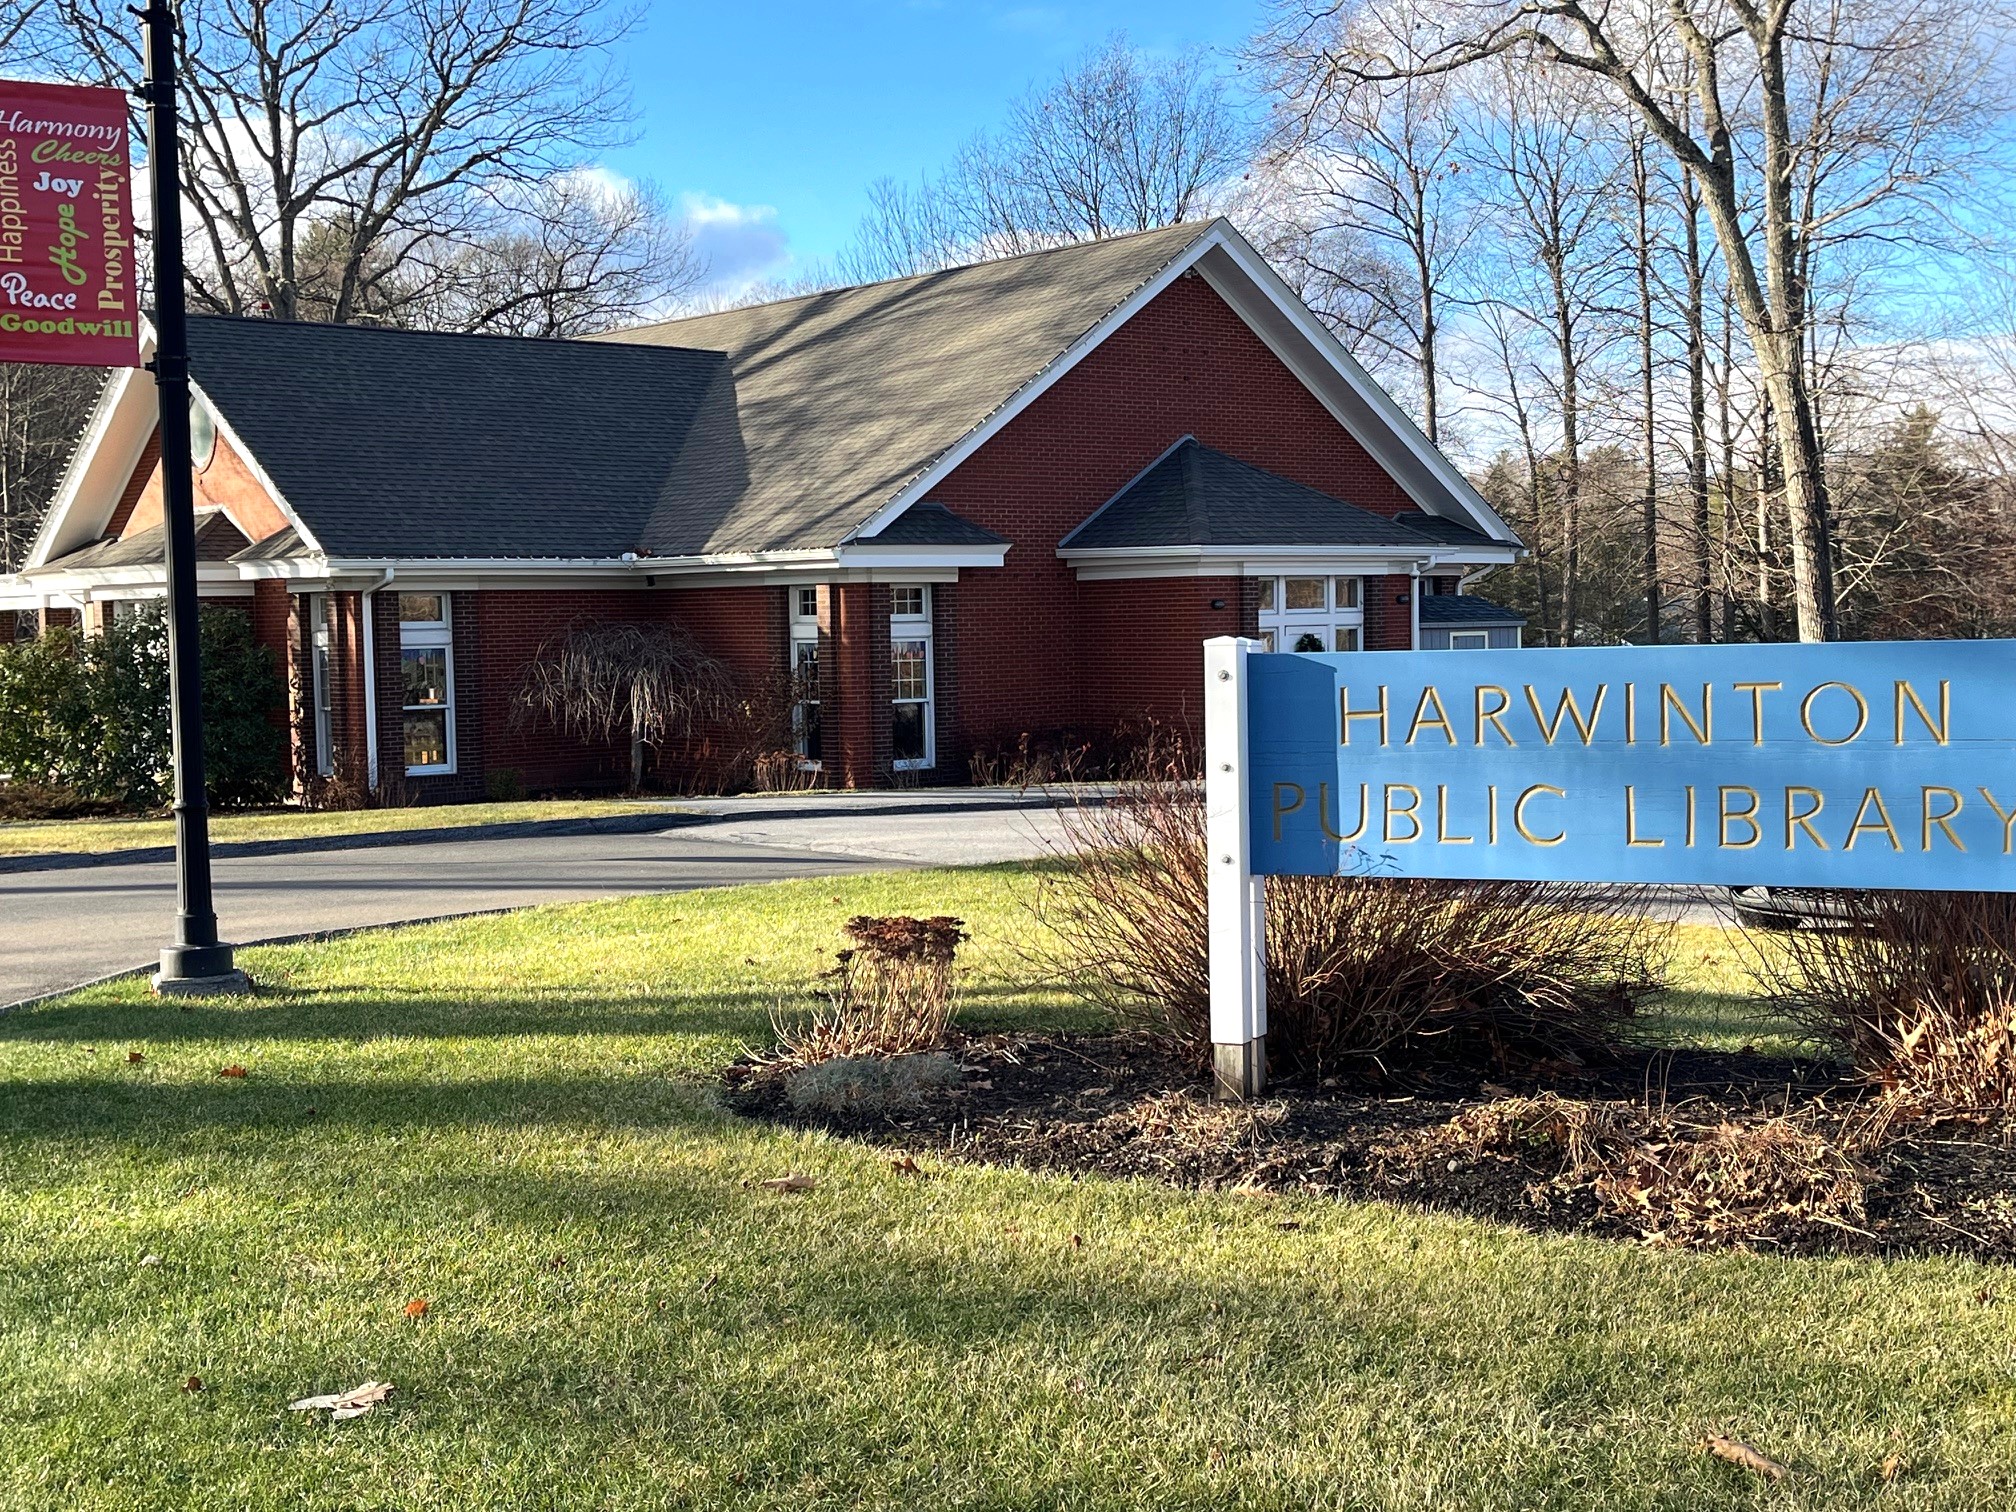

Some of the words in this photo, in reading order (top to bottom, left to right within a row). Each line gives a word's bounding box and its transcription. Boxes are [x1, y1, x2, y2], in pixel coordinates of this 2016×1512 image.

[0, 110, 121, 151] Harmony
[31, 139, 123, 166] Cheers
[0, 138, 28, 263] Happiness
[33, 171, 84, 198] Joy
[48, 203, 90, 286] Hope
[92, 165, 129, 312] Prosperity
[0, 272, 77, 310] Peace
[0, 313, 133, 338] Goodwill
[1339, 680, 1951, 747] HARWINTON
[1271, 782, 1567, 847] PUBLIC
[1624, 785, 2016, 855] LIBRARY
